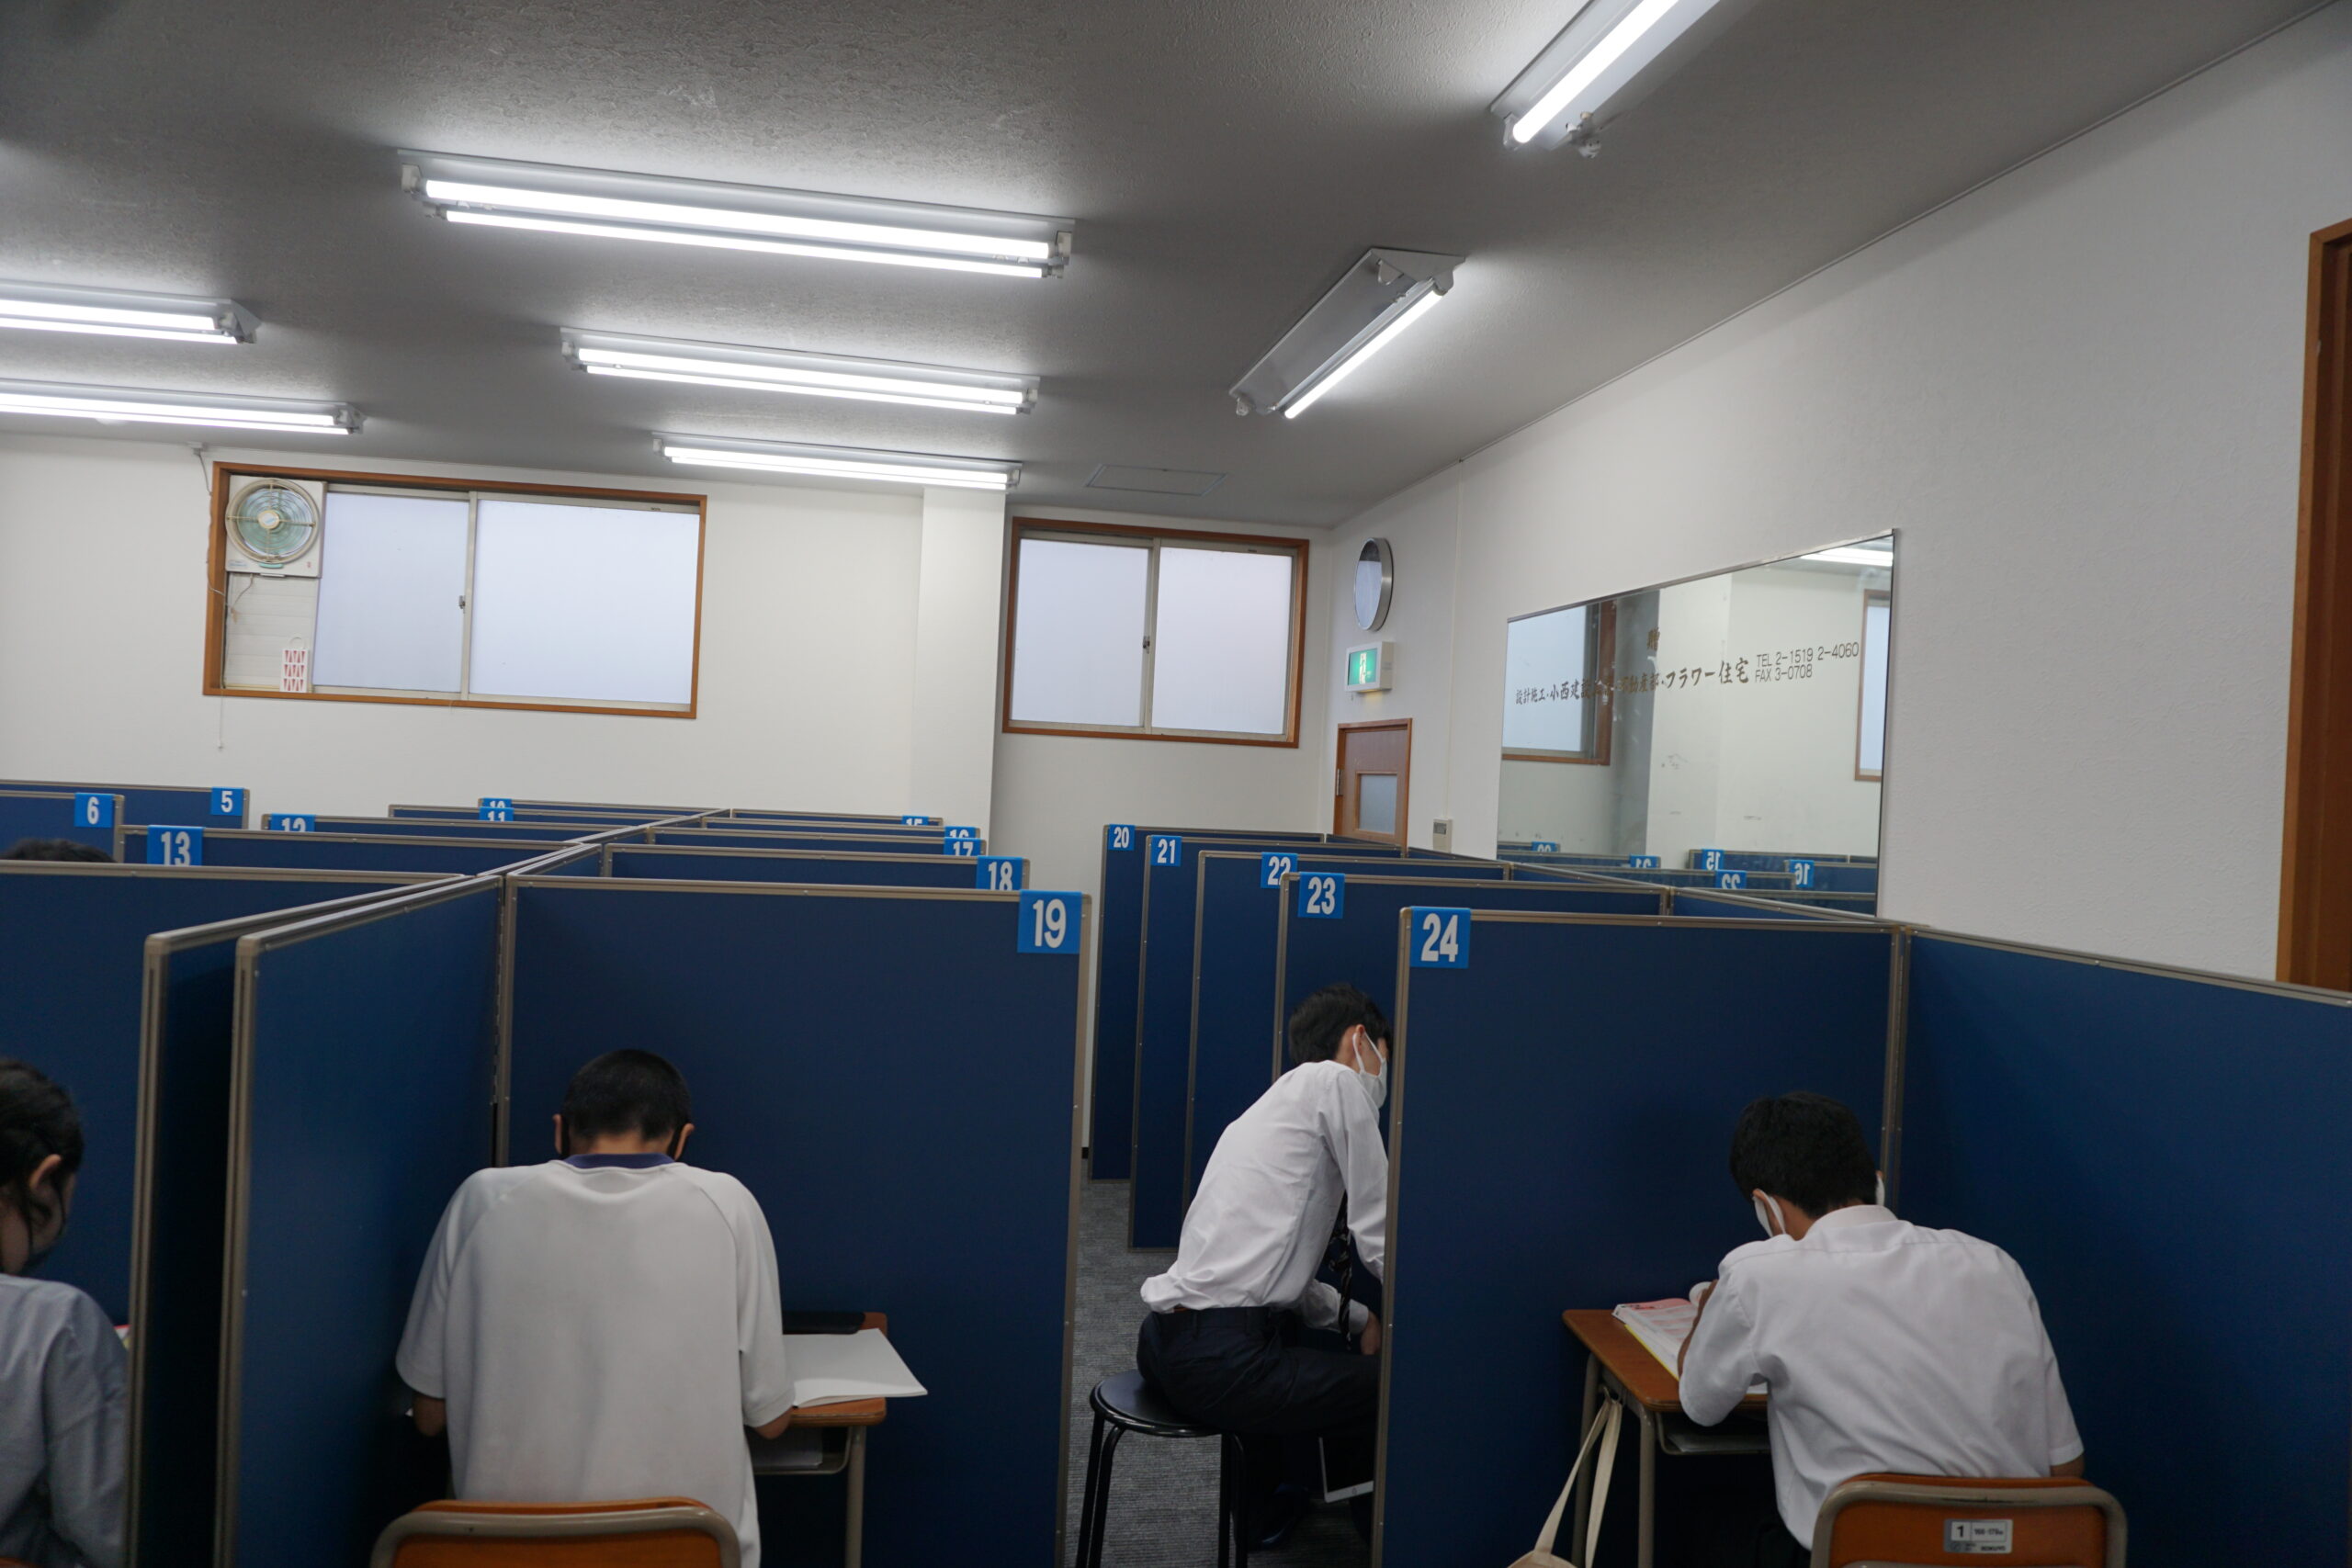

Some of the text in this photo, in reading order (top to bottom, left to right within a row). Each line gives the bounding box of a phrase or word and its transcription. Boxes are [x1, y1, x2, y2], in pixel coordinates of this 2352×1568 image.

[1756, 641, 1860, 668] TEL 2-1519 2-4060
[1755, 663, 1813, 683] FAX 3-0708
[86, 796, 100, 825] 6
[220, 790, 233, 813] 5
[161, 830, 191, 866] 13
[1113, 826, 1130, 849] 20
[1157, 838, 1177, 864] 21
[988, 861, 1013, 891] 18
[1267, 855, 1292, 886] 22
[1306, 875, 1336, 915] 23
[1033, 898, 1067, 949] 19
[1420, 912, 1459, 963] 24
[1957, 1525, 1964, 1538] 1
